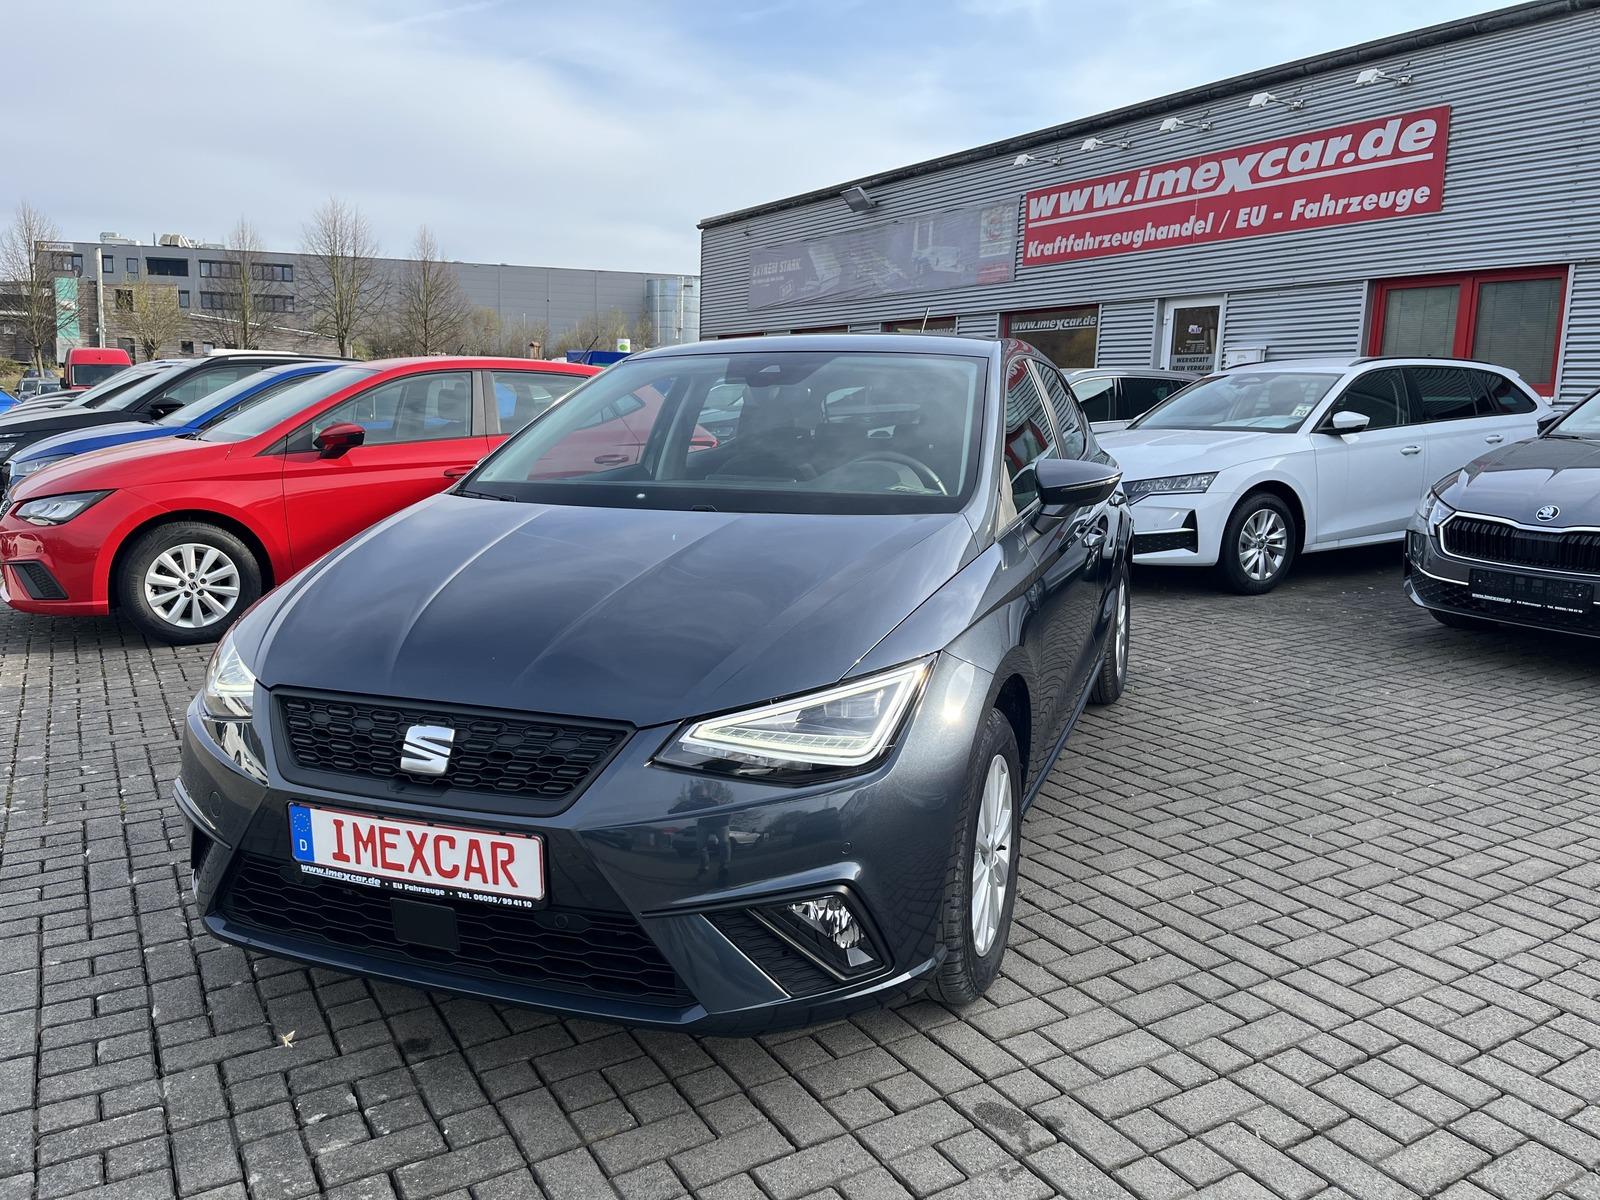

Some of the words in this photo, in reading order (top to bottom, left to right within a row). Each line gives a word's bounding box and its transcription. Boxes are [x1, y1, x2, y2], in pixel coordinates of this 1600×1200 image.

[1029, 117, 1437, 220] www.imexcar.de
[1026, 211, 1214, 258] Kraftfahrzeughandel
[1235, 204, 1267, 229] EU
[1290, 185, 1431, 222] Fahrzeuge
[1011, 315, 1097, 331] www.imexcar.de
[1176, 356, 1209, 364] WERKSTATT
[299, 838, 308, 851] D
[331, 818, 519, 889] IMEXCAR
[300, 863, 381, 887] www.imexcar.de
[392, 881, 403, 890] EU
[404, 883, 446, 897] Fahrzeuge
[457, 891, 473, 900] Tel.
